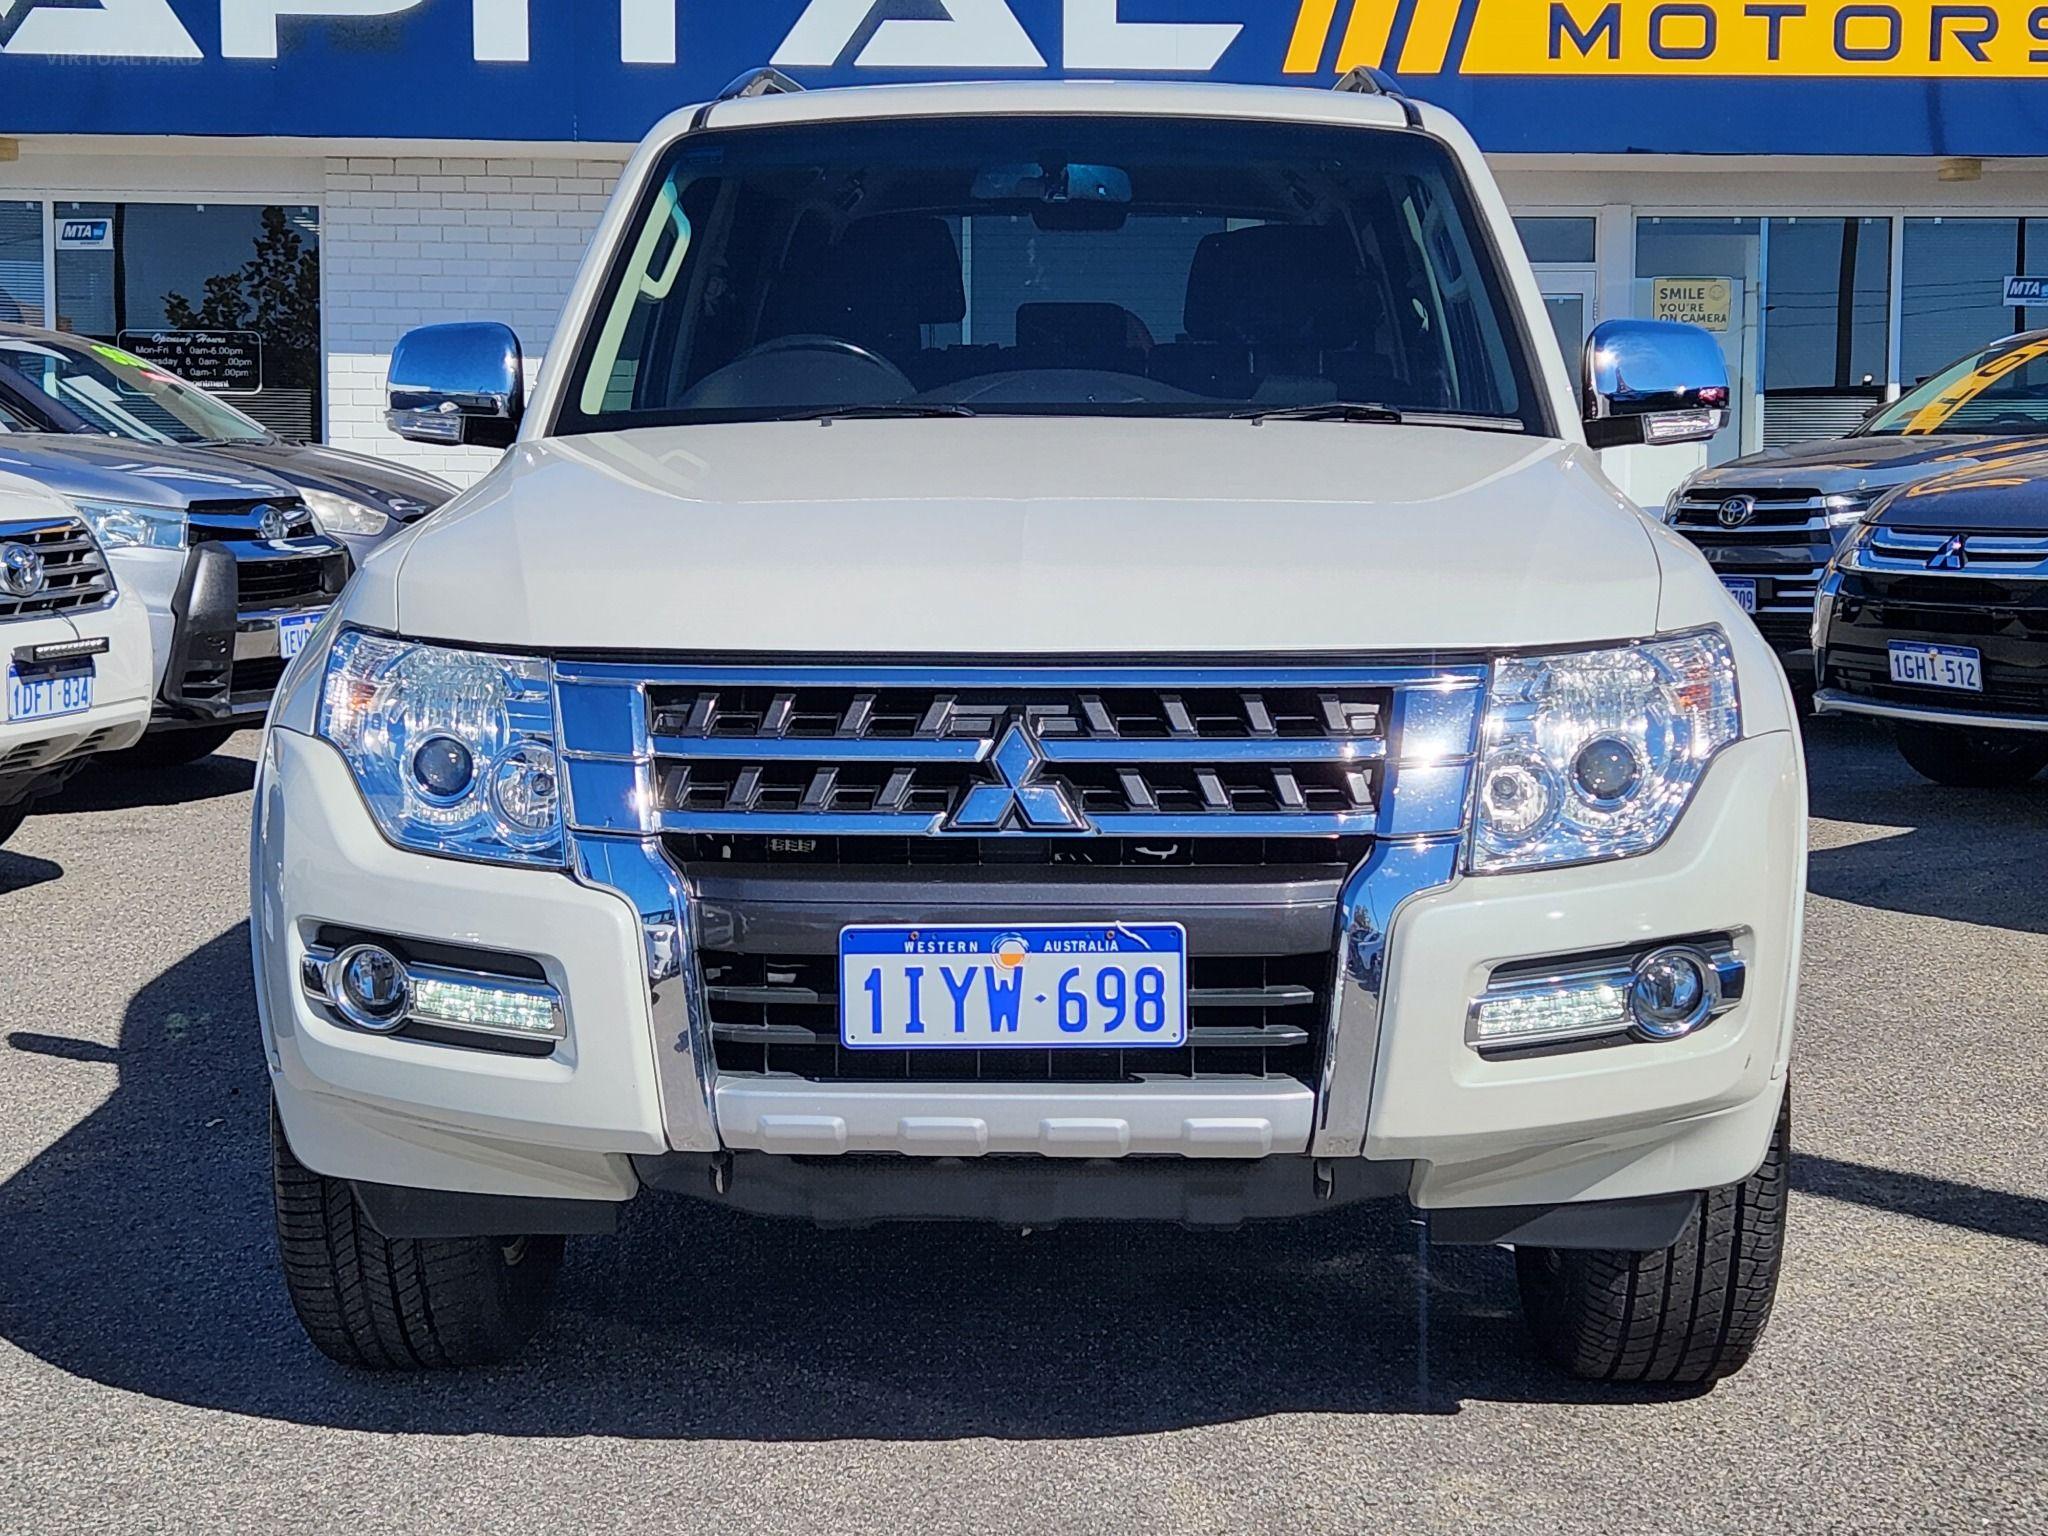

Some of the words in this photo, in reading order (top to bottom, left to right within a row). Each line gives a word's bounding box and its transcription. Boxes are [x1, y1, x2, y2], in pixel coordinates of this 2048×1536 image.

[63, 225, 92, 238] MTA
[2010, 281, 2040, 295] MTA
[1660, 288, 1705, 300] SMILE
[1660, 303, 1705, 312] YOU'RE
[1660, 313, 1677, 322] ON
[1680, 313, 1727, 323] CAMERA
[195, 333, 226, 343] Hours
[135, 346, 169, 354] Mon-Fri
[904, 941, 978, 953] WESTERN
[1044, 940, 1119, 952] AUSTRALIA
